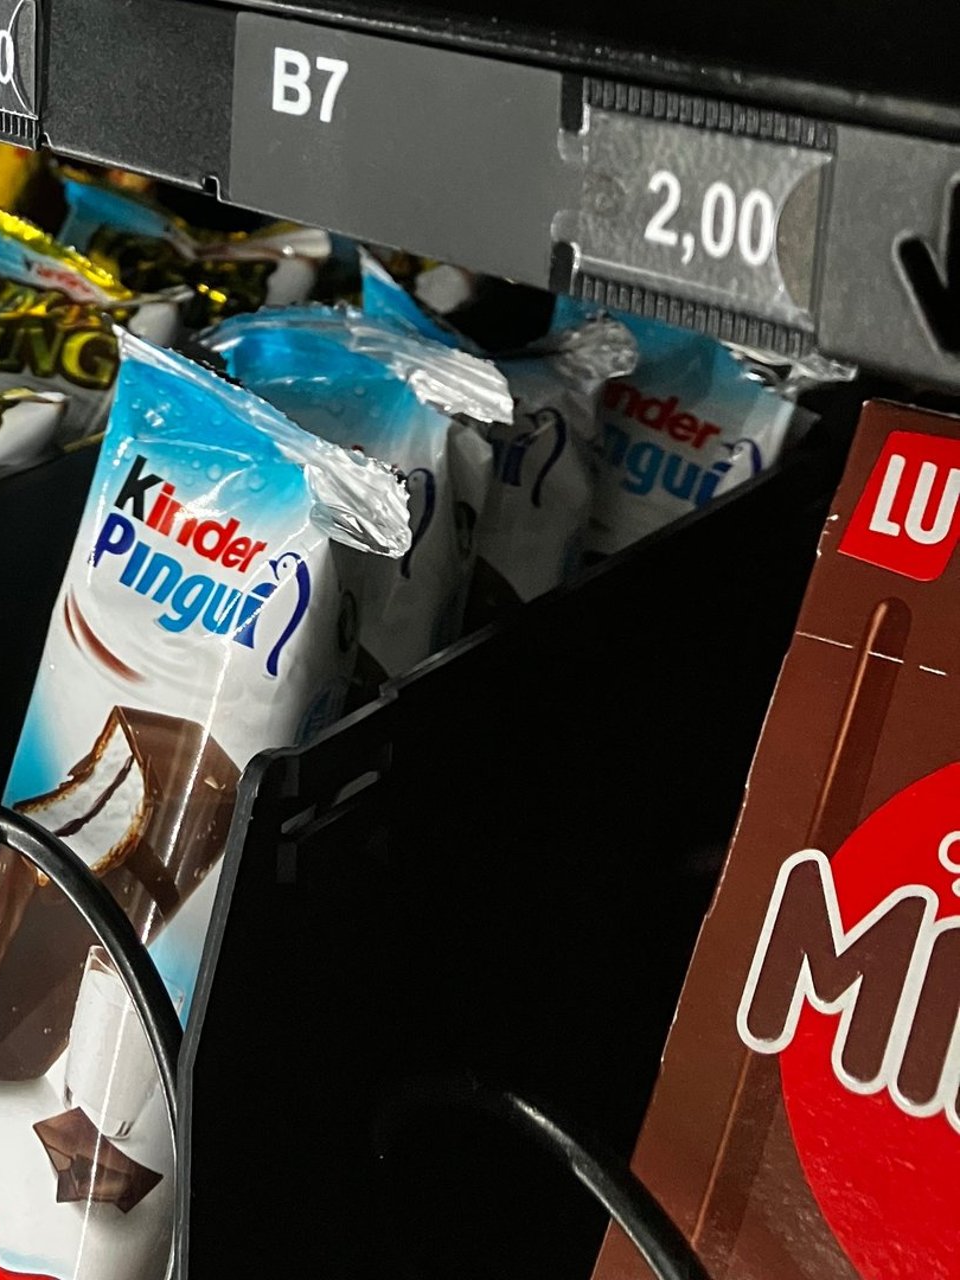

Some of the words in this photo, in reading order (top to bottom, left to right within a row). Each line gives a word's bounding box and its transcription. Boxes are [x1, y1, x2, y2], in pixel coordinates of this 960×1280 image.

[271, 46, 349, 123] B7
[643, 169, 775, 266] 2,00
[869, 453, 960, 545] LU
